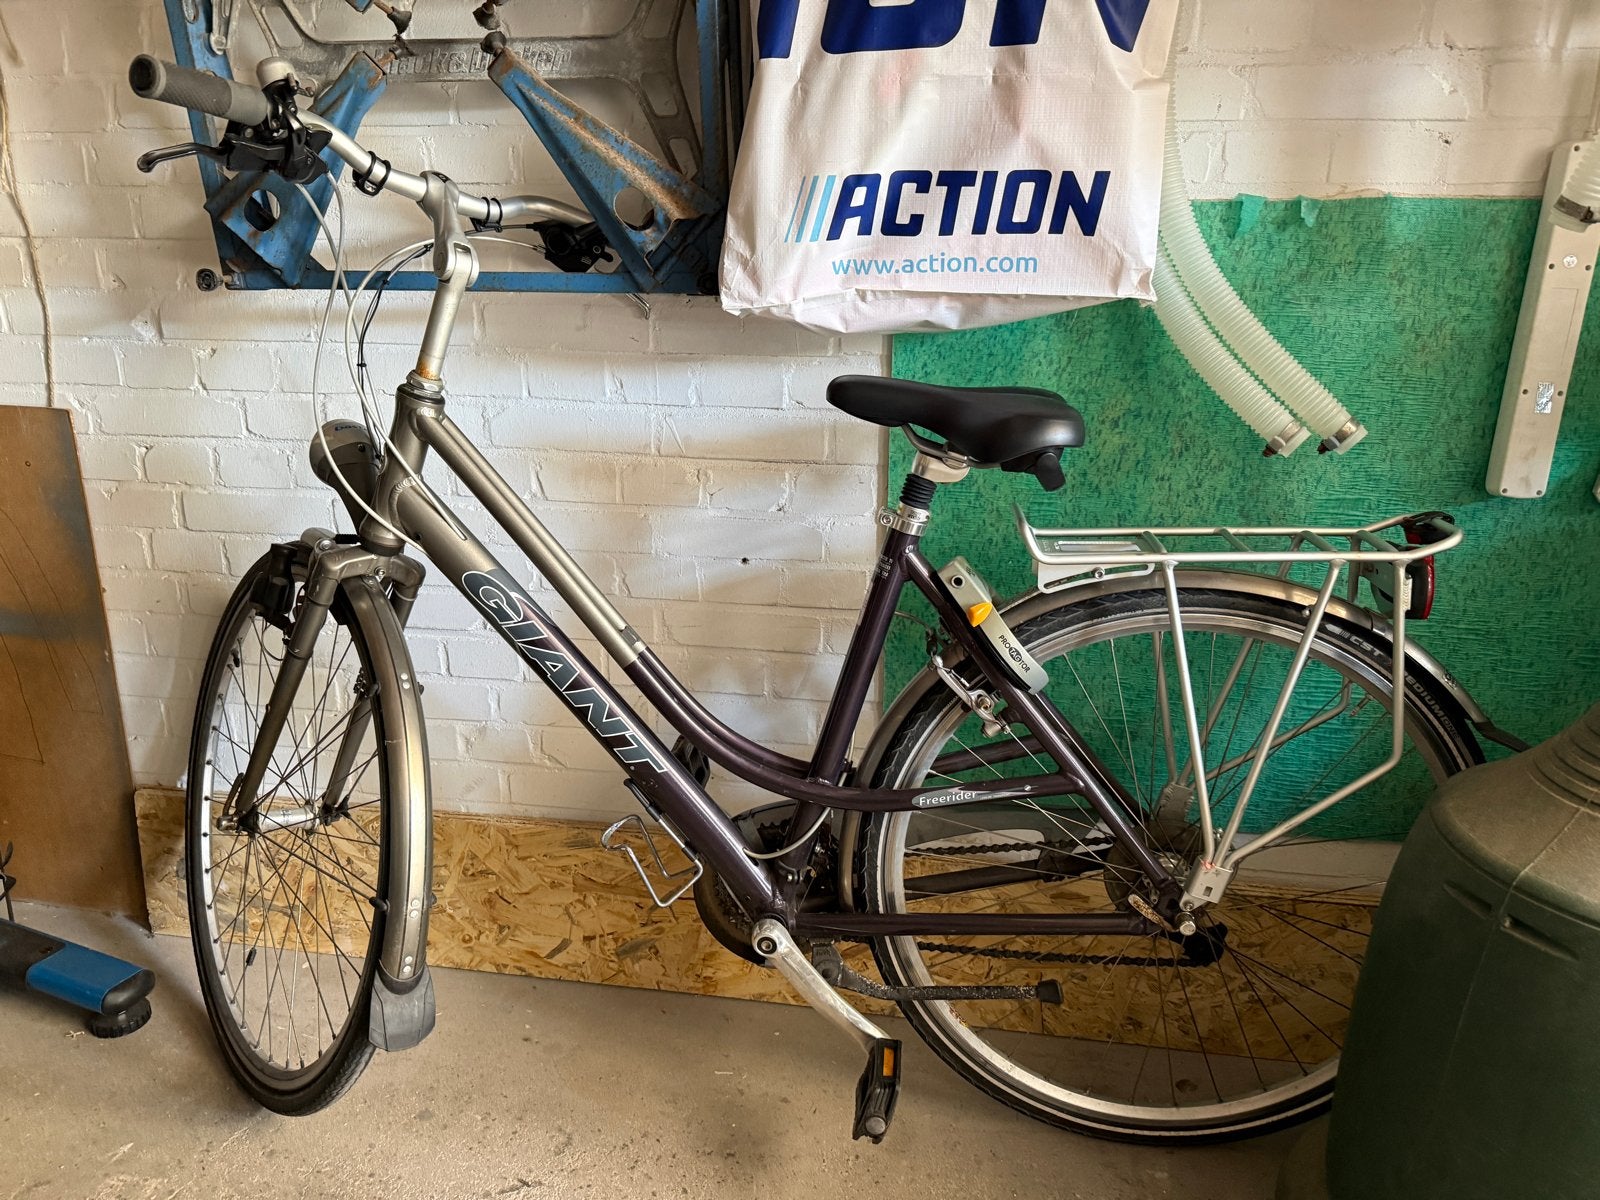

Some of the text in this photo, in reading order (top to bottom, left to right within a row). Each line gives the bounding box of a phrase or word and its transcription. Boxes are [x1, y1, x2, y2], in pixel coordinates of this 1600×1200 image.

[826, 169, 1111, 242] ACTION
[832, 252, 1038, 276] www.action.com
[1350, 636, 1384, 657] CST
[461, 571, 668, 773] GIANT
[919, 789, 977, 807] Freerider
